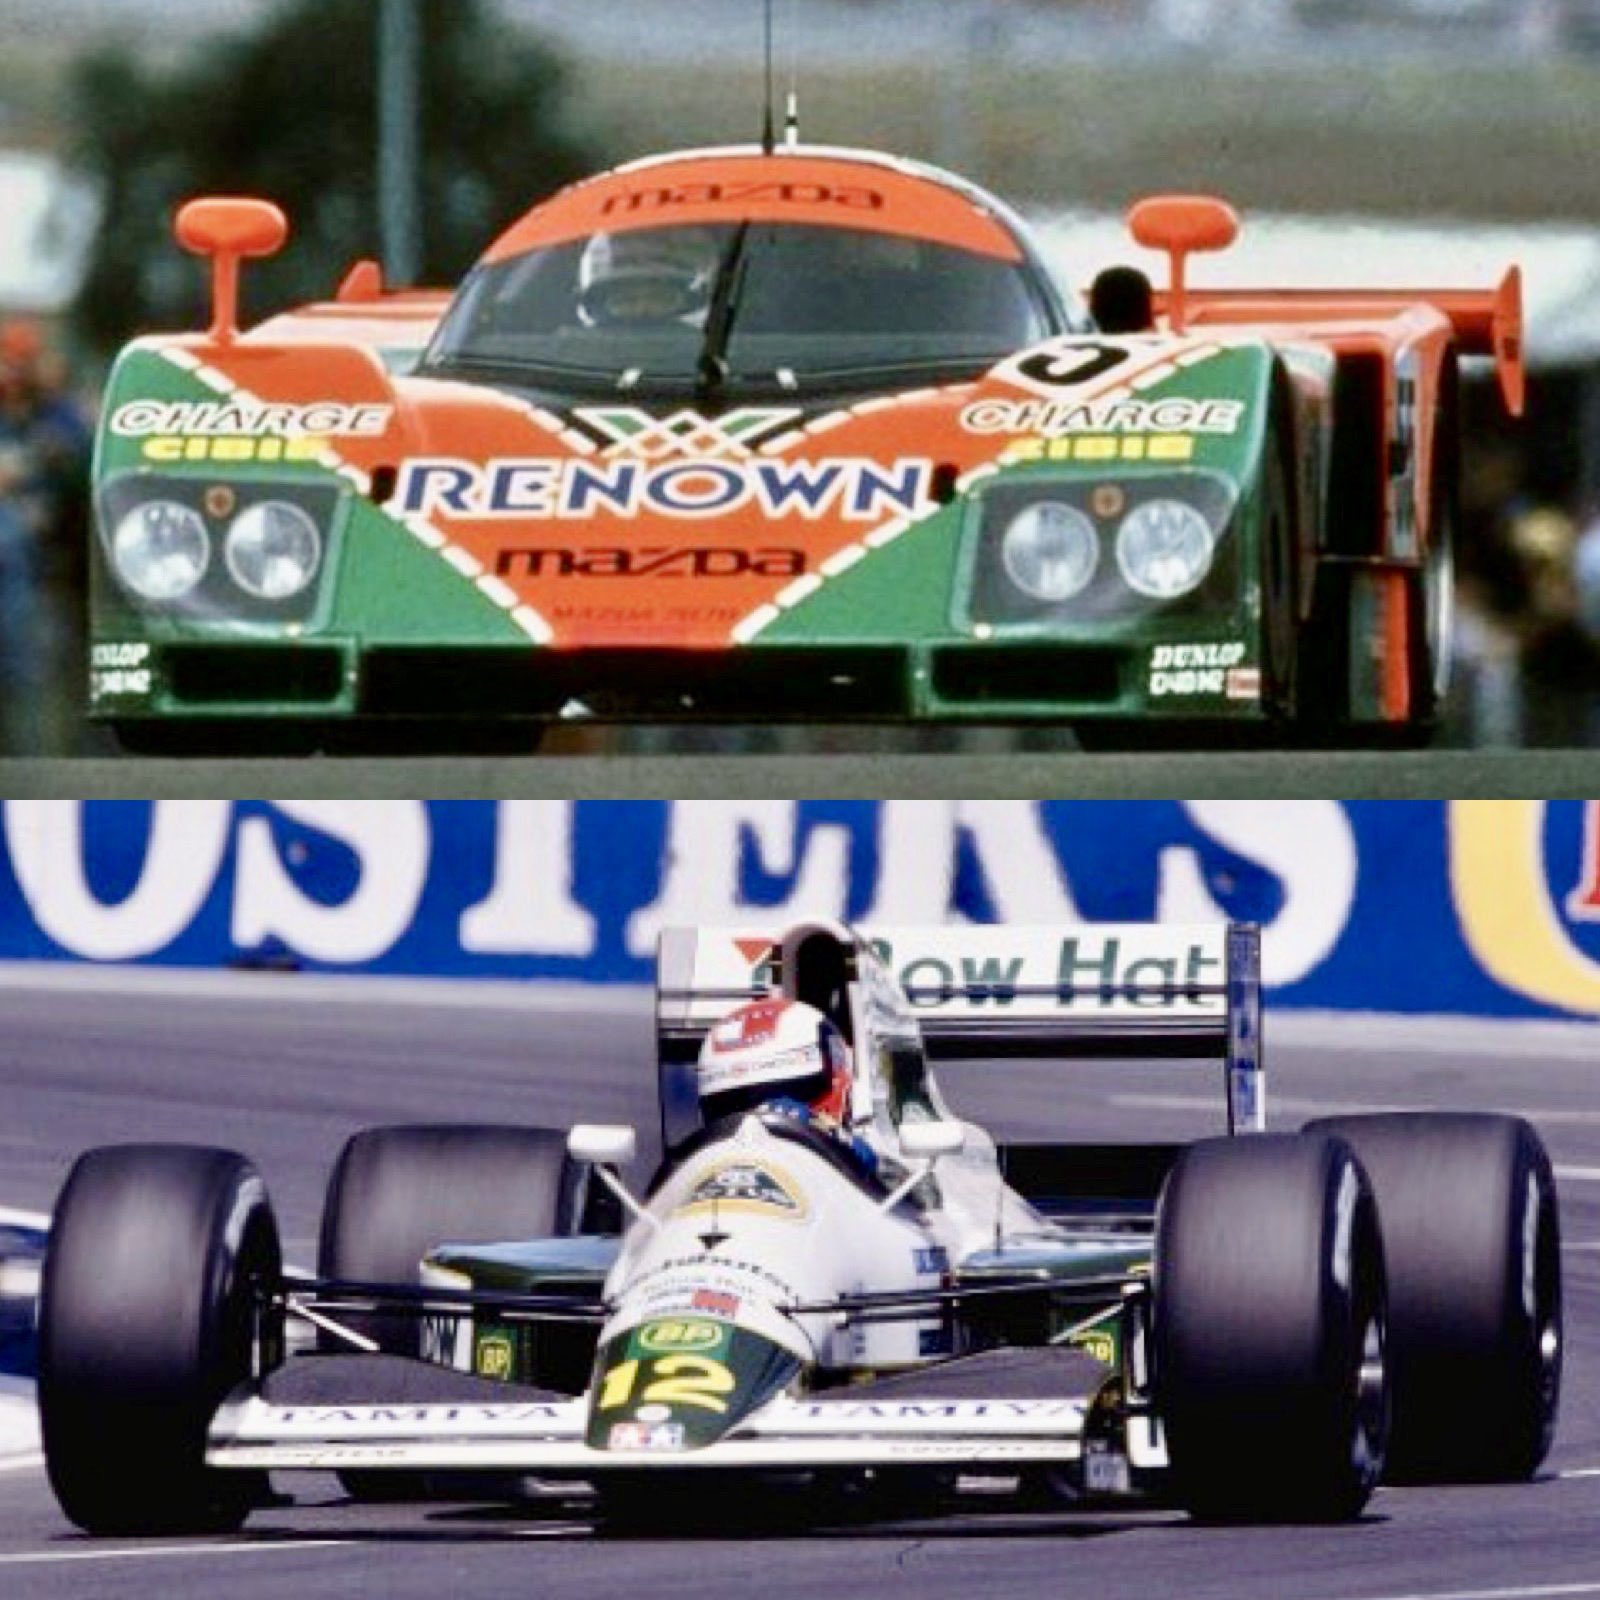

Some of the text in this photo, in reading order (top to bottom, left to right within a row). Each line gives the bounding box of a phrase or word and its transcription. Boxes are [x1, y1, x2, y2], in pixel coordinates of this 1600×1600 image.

[111, 401, 394, 436] CHARGE
[960, 399, 1245, 434] CHARGE
[396, 459, 932, 519] RENOWN
[1056, 938, 1220, 1010] Hat
[599, 1356, 736, 1413] 12
